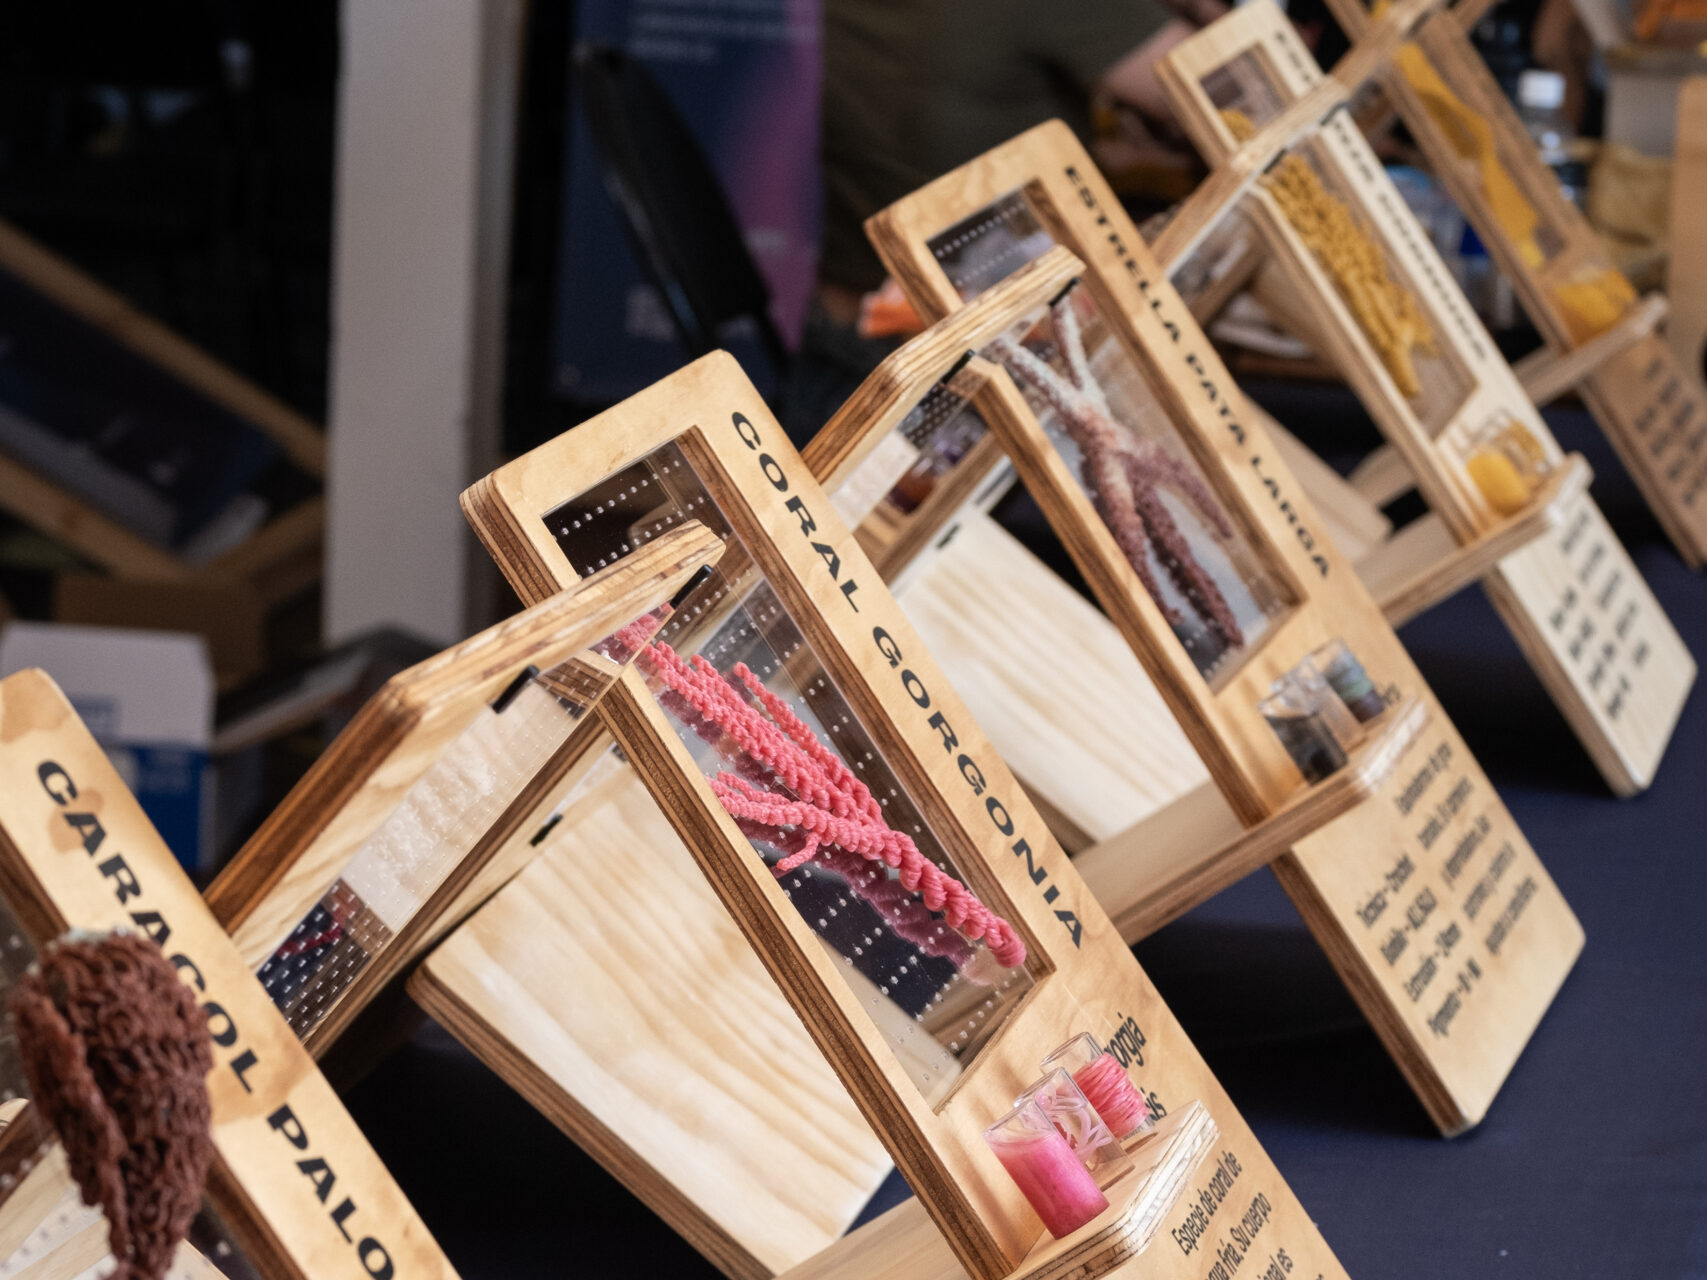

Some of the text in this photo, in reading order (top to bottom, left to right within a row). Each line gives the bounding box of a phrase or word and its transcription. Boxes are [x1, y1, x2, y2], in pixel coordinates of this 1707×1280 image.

[1065, 166, 1329, 578] ESTRELLA PATA LARGA
[731, 411, 1083, 949] CORAL GORGONIA
[37, 761, 259, 1094] CARACOL
[1171, 1150, 1242, 1256] Especie de coral de
[1230, 1224, 1251, 1252] Su
[1241, 1192, 1272, 1238] cuerpo
[1277, 1248, 1293, 1273] es
